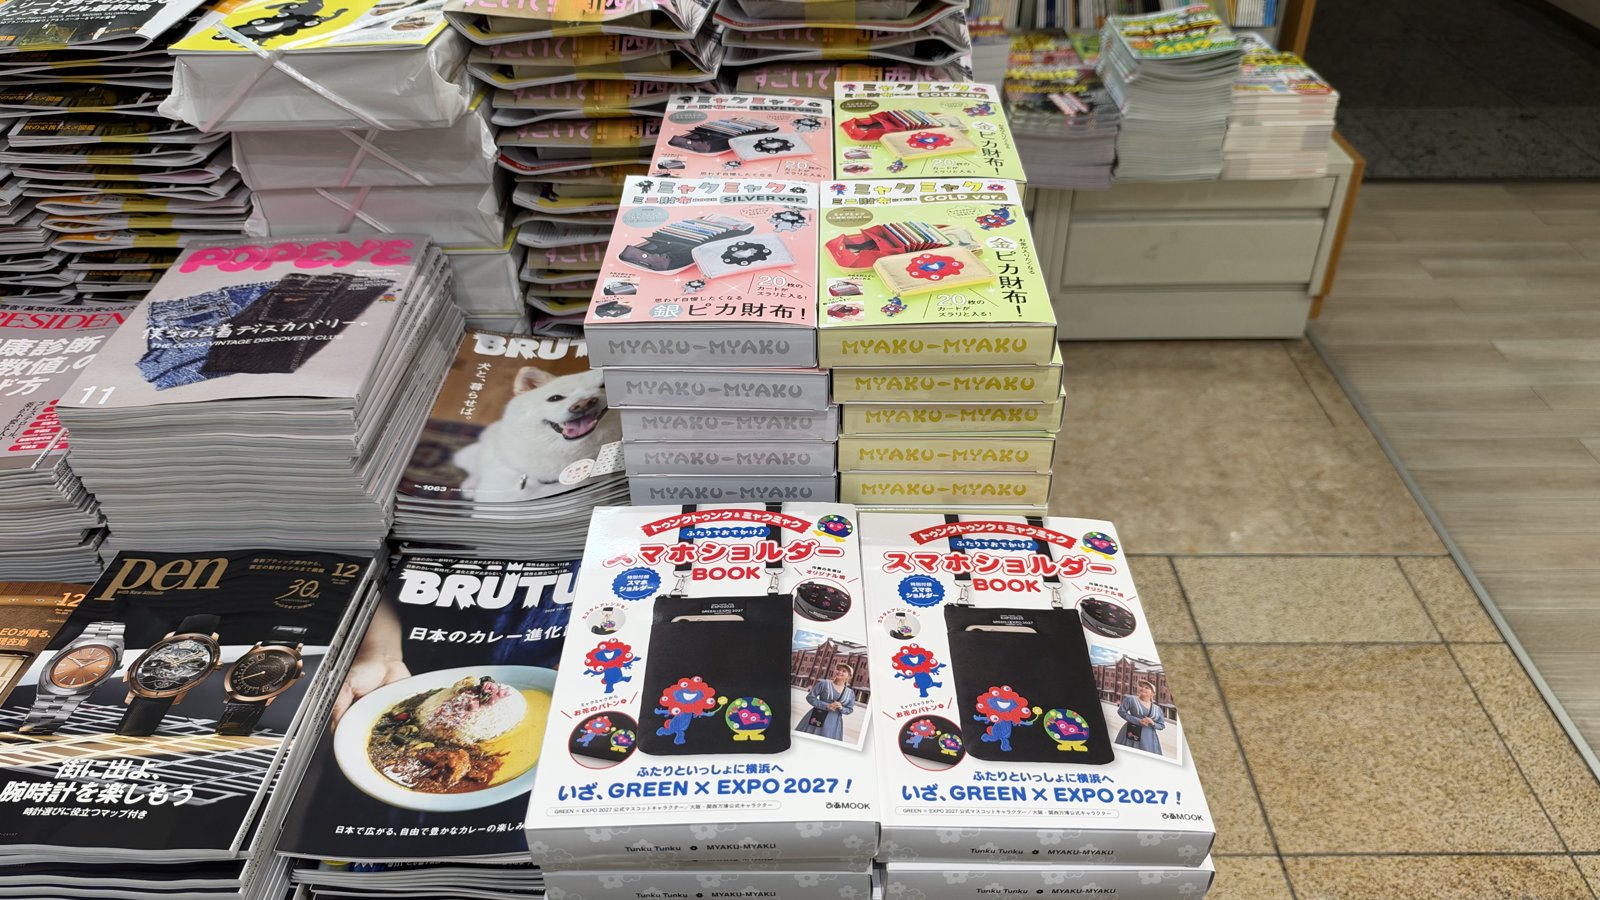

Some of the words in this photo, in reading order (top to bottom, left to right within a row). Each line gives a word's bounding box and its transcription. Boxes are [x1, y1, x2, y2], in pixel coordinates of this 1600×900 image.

[657, 181, 787, 194] ミャクミャク
[854, 181, 984, 194] ミャクミャク
[723, 195, 776, 203] SILVER
[924, 193, 968, 202] GOLD
[180, 239, 415, 274] POPEYE
[654, 295, 743, 303] 思わず自慢したくなる
[151, 342, 173, 350] THE
[173, 341, 208, 349] GOOD
[209, 338, 253, 347] VINTAGE
[253, 335, 314, 344] DISCOVERY
[314, 333, 344, 341] CLUB
[608, 339, 791, 356] MYAKU-MYAKU
[841, 337, 1028, 354] MYAKU-MYAKU
[625, 380, 803, 399] MYAKU-MYAKU
[854, 375, 1036, 392] MYAKU-MYAKU
[79, 385, 117, 405] 11
[641, 415, 813, 431] MYAKU-MYAKU
[864, 408, 1039, 424] MYAKU-MYAKU
[643, 450, 811, 466] MYAKU-MYAKU
[858, 447, 1029, 463] MYAKU-MYAKU
[649, 486, 813, 501] MYAKU-MYAKU
[860, 481, 1027, 498] MYAKU-MYAKU
[604, 541, 845, 567] スマホショルダー
[331, 562, 360, 578] 12
[884, 552, 1117, 577] スマホショルダー
[94, 557, 232, 601] pen
[692, 567, 761, 581] BOOK
[973, 578, 1042, 593] BOOK
[409, 625, 569, 645] 日本のカレー進化
[54, 758, 160, 780] 街に出よ、
[636, 762, 784, 777] ふたりといっしょに横浜へ
[972, 770, 1115, 783] ふたりといっしょに横浜へ
[0, 780, 194, 806] 腕時計を楽しもう
[717, 779, 780, 794] EXPO
[1054, 787, 1114, 803] EXPO
[22, 807, 148, 820] 時計選びに役立つマップ付き
[825, 801, 871, 810] ぴあMOOK
[706, 842, 777, 851] MYAKU-MYAKU
[635, 891, 661, 899] Tunku
[662, 891, 688, 899] Tunku
[711, 890, 777, 898] MYAKU-MYAKU
[976, 887, 1002, 895] Tunku
[1003, 887, 1028, 895] Tunku
[1051, 887, 1117, 895] MYAKU-MYAKU
